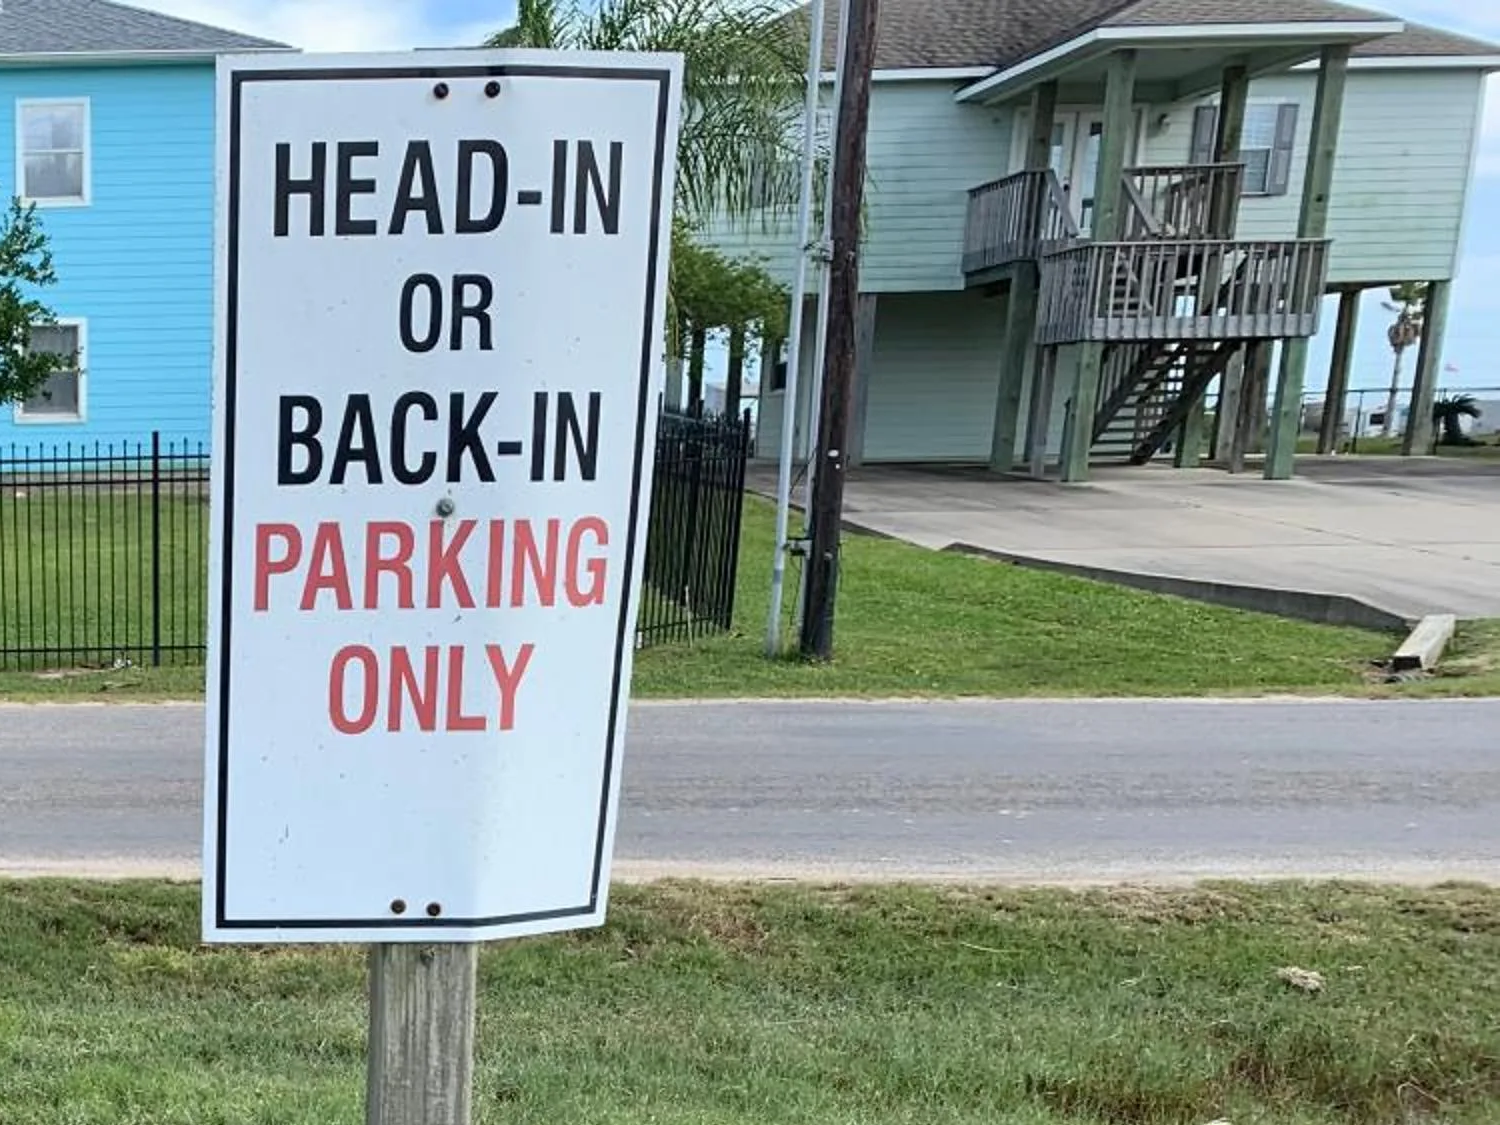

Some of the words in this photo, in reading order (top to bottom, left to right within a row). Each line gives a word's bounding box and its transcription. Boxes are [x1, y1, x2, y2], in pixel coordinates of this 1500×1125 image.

[273, 139, 624, 238] HEAD-IN
[399, 272, 494, 353] OR
[277, 391, 601, 487] BACK-IN
[254, 516, 609, 612] PARKING
[328, 643, 535, 735] ONLY
